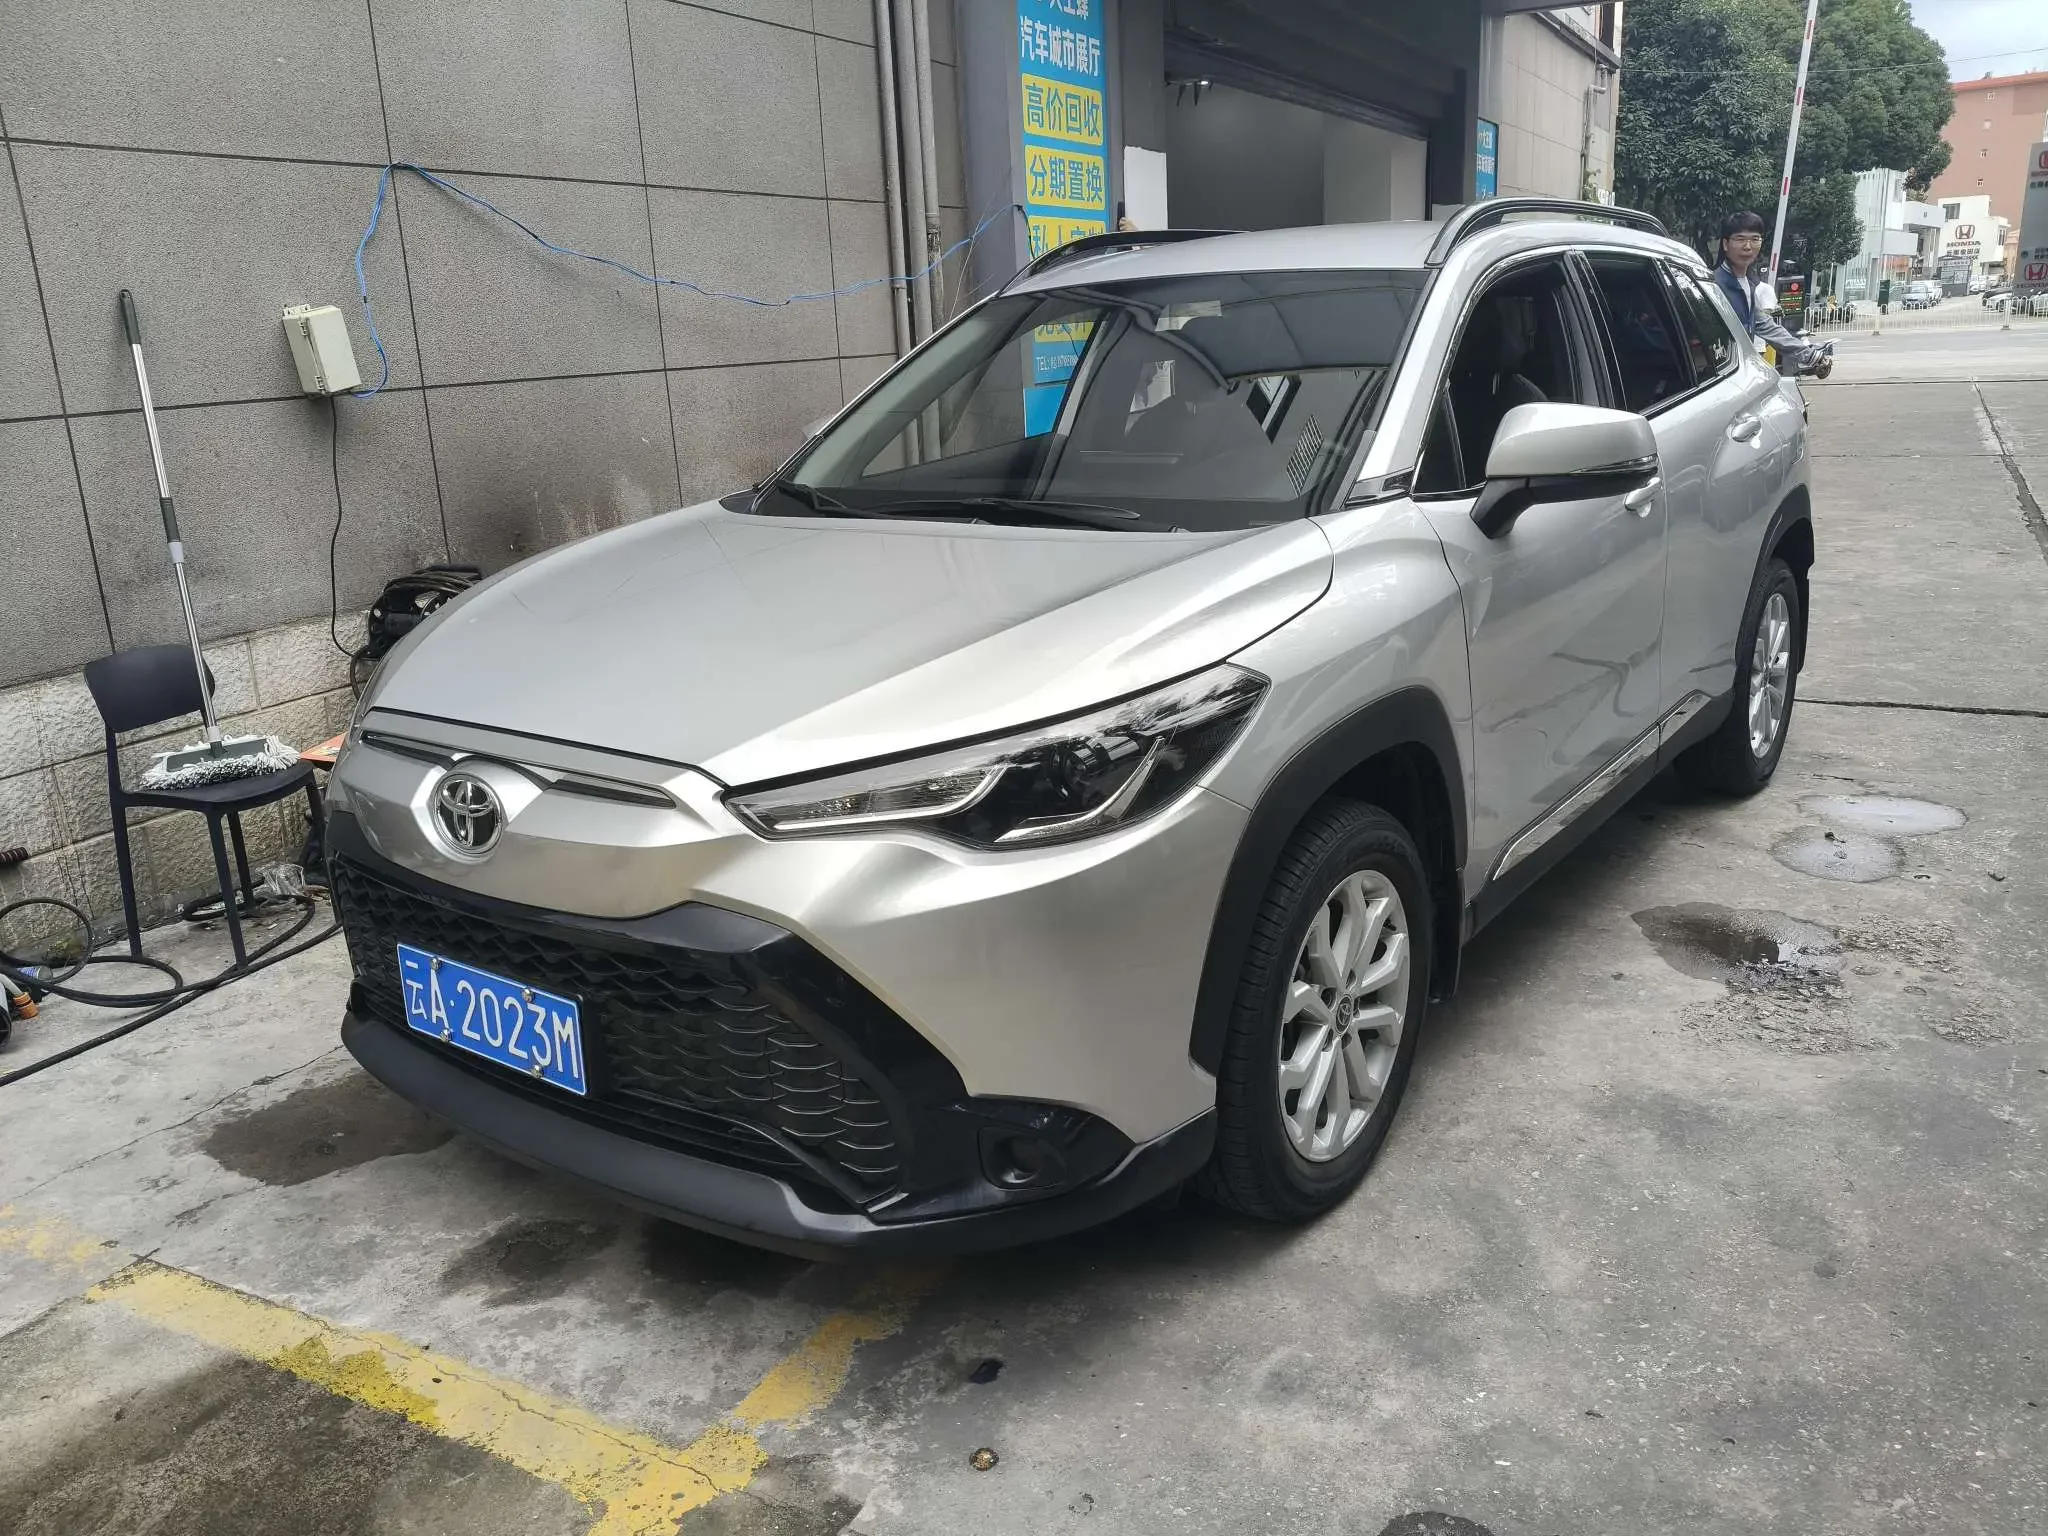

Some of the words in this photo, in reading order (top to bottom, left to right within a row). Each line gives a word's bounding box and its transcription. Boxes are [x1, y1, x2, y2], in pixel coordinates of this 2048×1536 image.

[1020, 16, 1100, 77] 汽车城市展厅
[1025, 83, 1102, 138] 高价回收
[1029, 154, 1103, 204] 分期置换
[1947, 240, 1981, 248] HONDA
